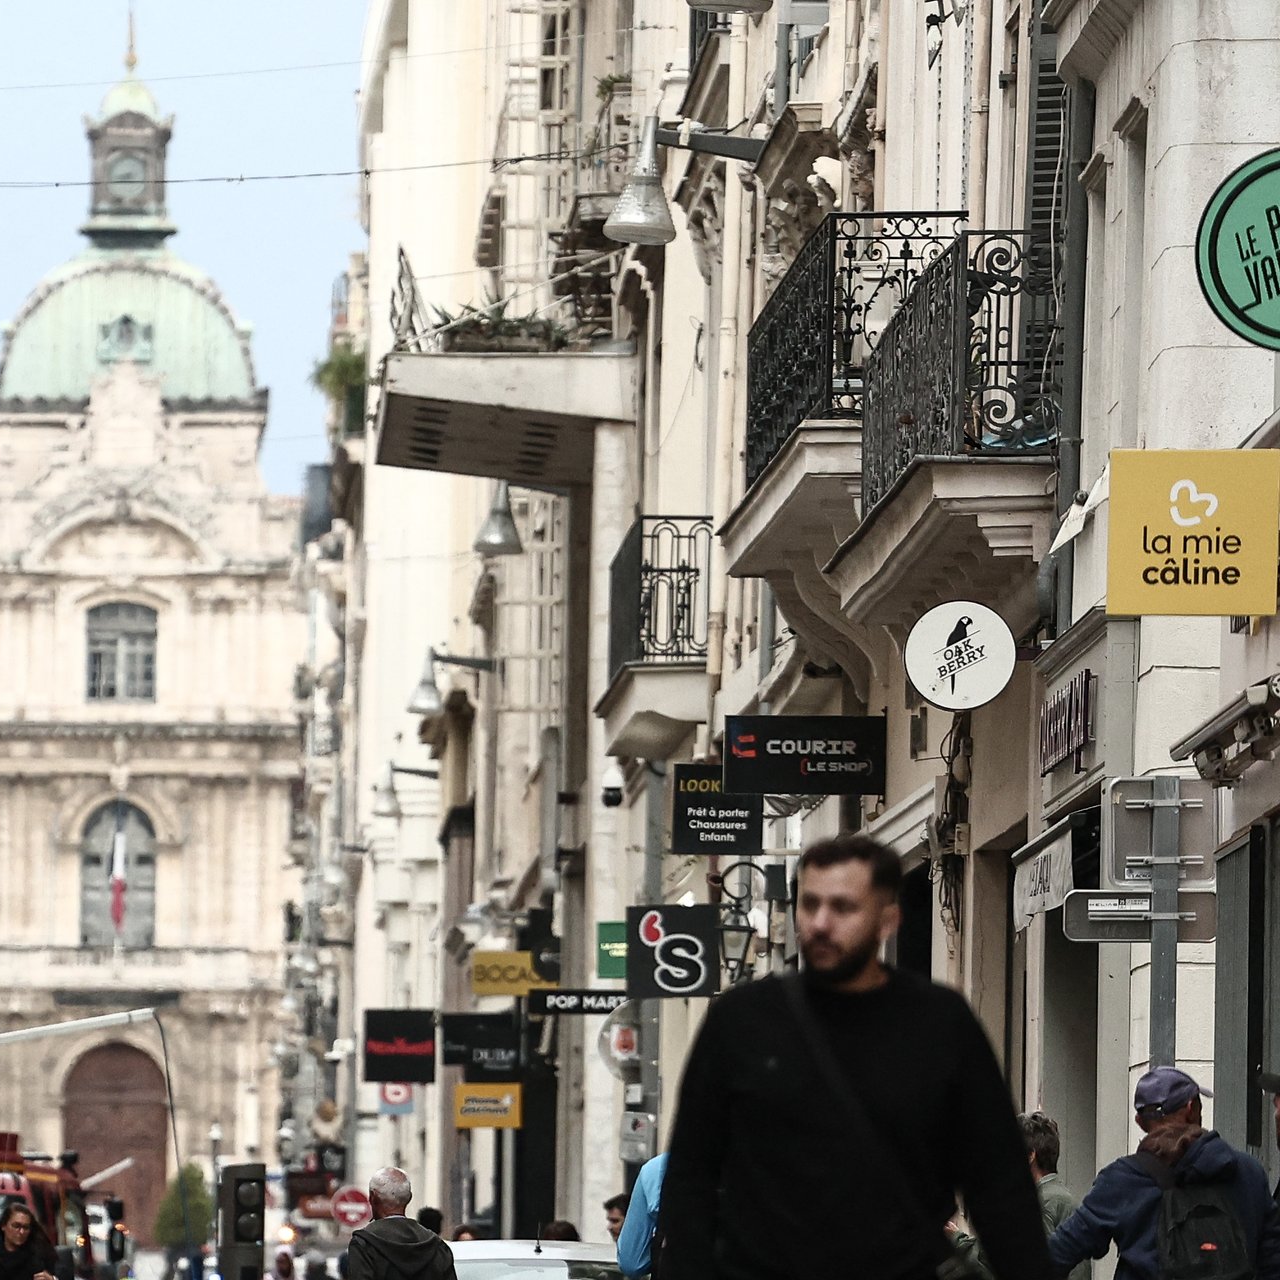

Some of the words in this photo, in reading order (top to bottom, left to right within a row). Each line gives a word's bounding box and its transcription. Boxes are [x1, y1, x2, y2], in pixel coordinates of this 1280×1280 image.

[1235, 225, 1261, 262] LE
[1143, 525, 1171, 554] la
[1183, 526, 1242, 554] mie
[1142, 557, 1241, 585] câline
[943, 639, 974, 661] OAK
[937, 645, 986, 678] BERRY
[766, 740, 857, 755] COURIR
[687, 807, 707, 817] Prêt
[709, 807, 717, 817] à
[718, 808, 750, 819] porter
[688, 820, 747, 830] Chaussures
[699, 832, 736, 842] Enfants
[546, 996, 578, 1009] POP
